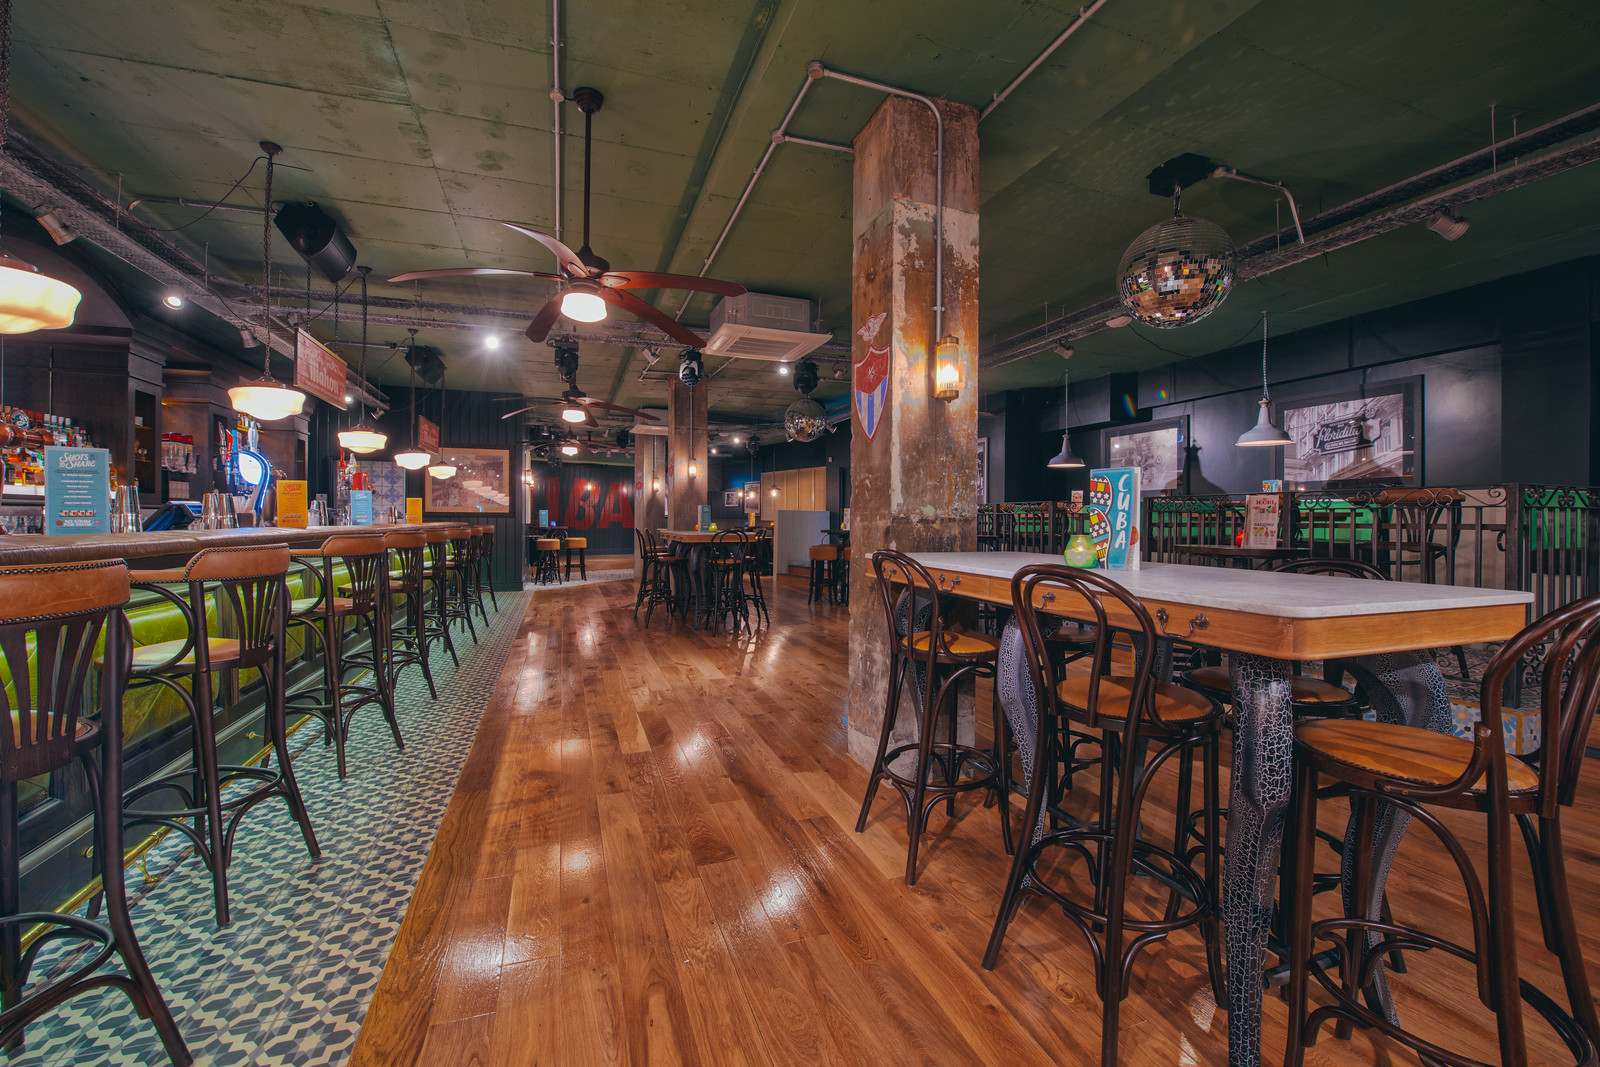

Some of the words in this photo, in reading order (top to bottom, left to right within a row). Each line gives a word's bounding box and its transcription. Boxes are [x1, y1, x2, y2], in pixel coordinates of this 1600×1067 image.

[310, 360, 339, 394] Mahou
[59, 452, 89, 463] SHOTS
[65, 460, 96, 469] SHARE
[1114, 473, 1130, 550] CUBA
